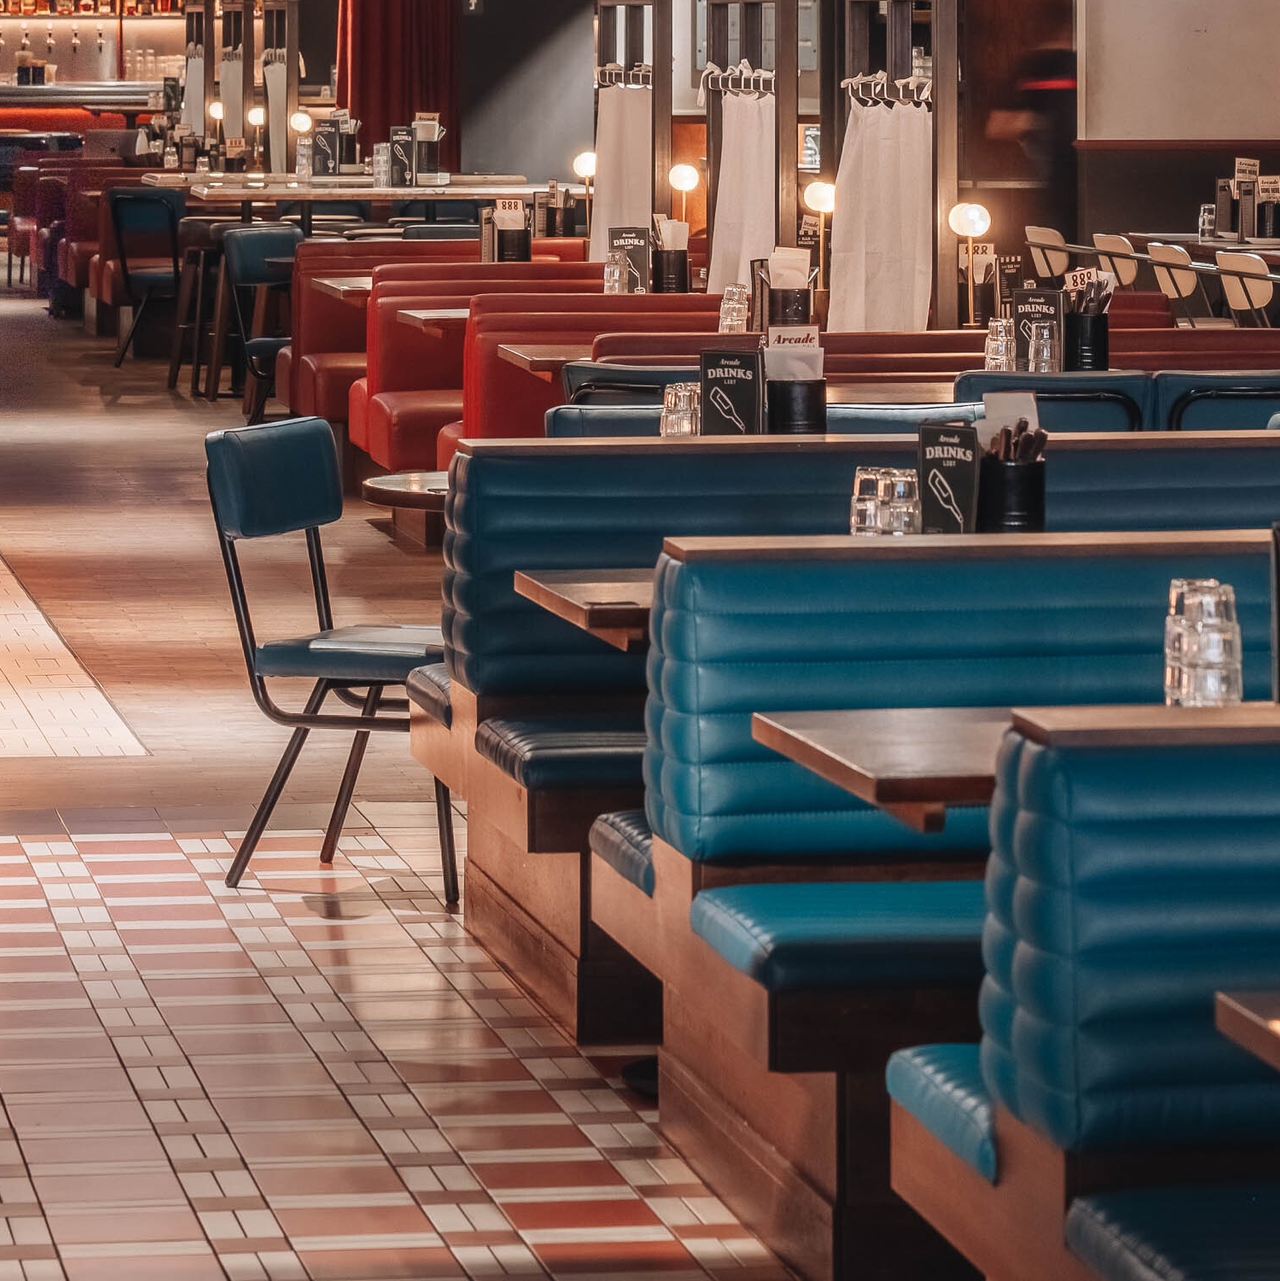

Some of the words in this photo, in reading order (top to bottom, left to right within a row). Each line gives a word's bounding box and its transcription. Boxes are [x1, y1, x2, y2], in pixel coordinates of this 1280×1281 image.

[502, 201, 518, 210] 888
[613, 238, 645, 246] DRINKS
[1018, 304, 1055, 314] DRINKS
[773, 333, 815, 345] Arcade
[707, 368, 753, 380] DRINKS
[925, 446, 973, 462] DRINKS
